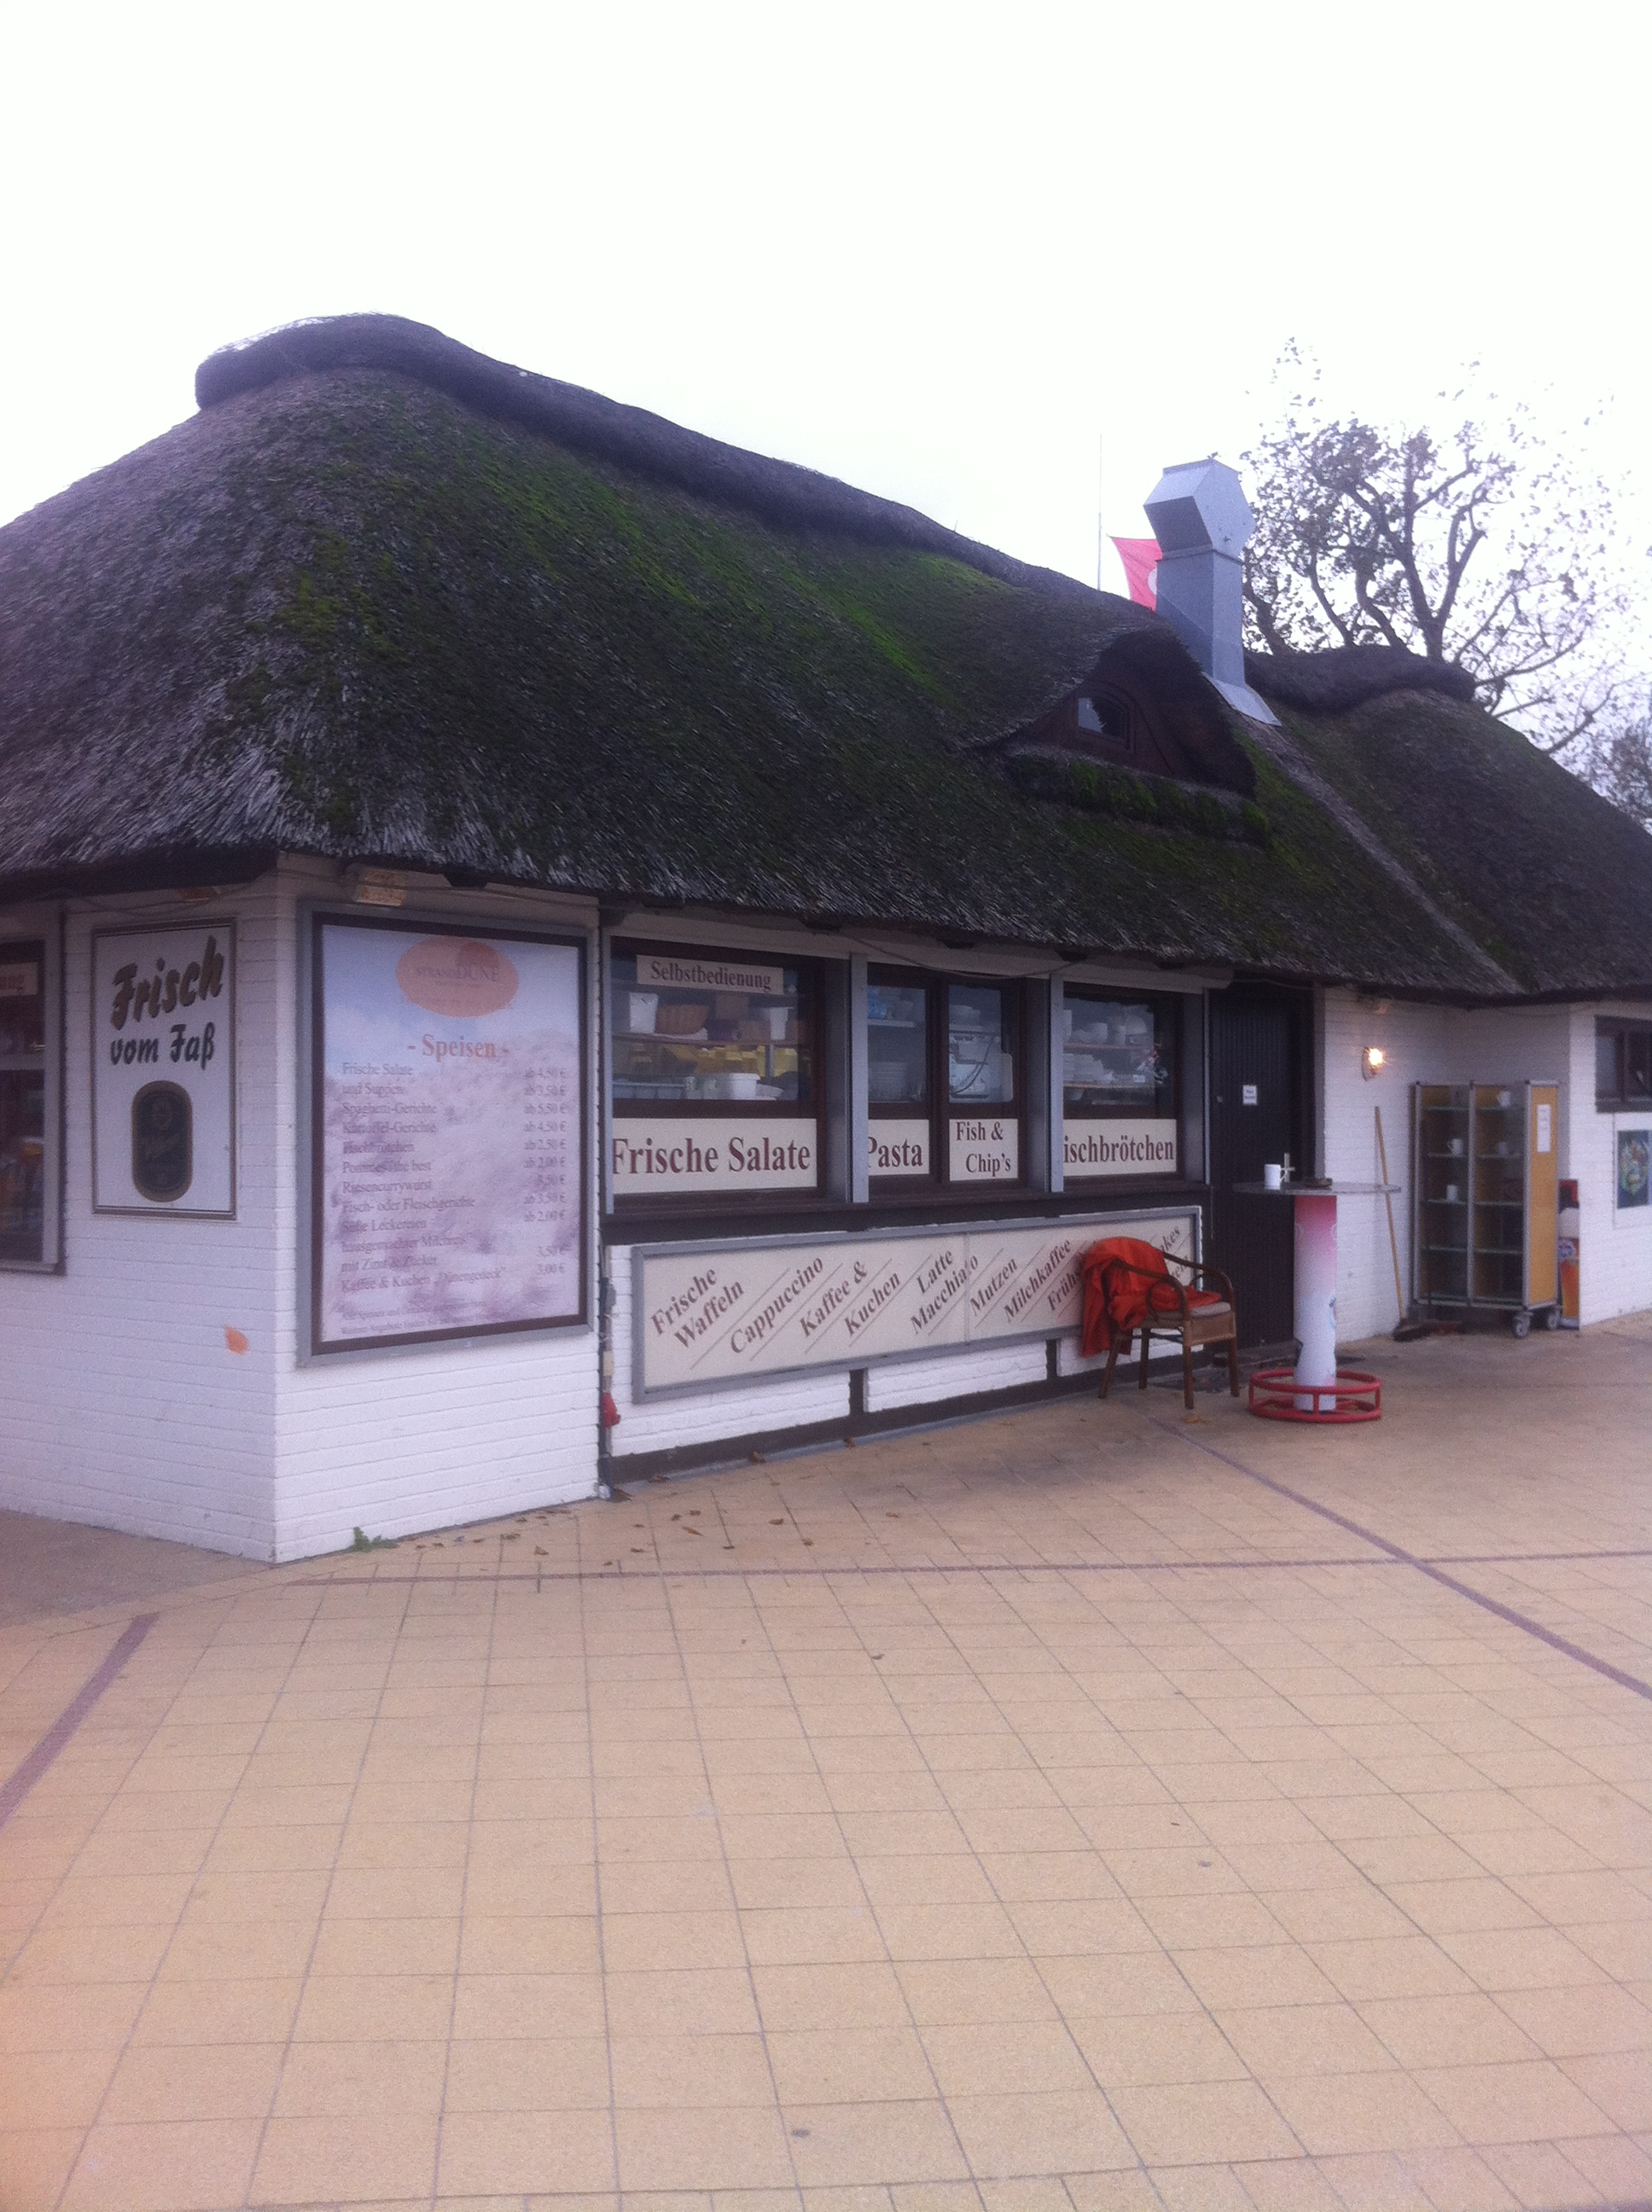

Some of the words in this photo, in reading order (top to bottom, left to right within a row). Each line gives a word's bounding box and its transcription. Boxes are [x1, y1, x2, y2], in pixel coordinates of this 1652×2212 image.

[111, 935, 224, 1031] Frisch
[650, 960, 771, 992] Selbstbedienung
[110, 1038, 160, 1065] vom
[170, 1022, 215, 1070] Faß
[342, 1062, 380, 1075] Frische
[422, 1033, 497, 1062] Speisen
[612, 1138, 719, 1175] Frische
[728, 1137, 811, 1173] Salate
[956, 1121, 986, 1142] Fish
[991, 1121, 1004, 1141] &
[1063, 1134, 1174, 1163] ischbrötchen
[965, 1152, 1011, 1178] Chip's
[910, 1254, 979, 1336] Macchiato
[916, 1249, 953, 1294] Latte
[969, 1257, 1018, 1316] Mutzen
[1004, 1240, 1070, 1323] Milchkaffee
[650, 1269, 718, 1336] Frische
[673, 1280, 745, 1348] Waffeln
[730, 1257, 823, 1353] Cappuccino
[800, 1280, 851, 1337] Kaffee
[853, 1260, 869, 1284] &
[844, 1272, 901, 1336] Kuchen
